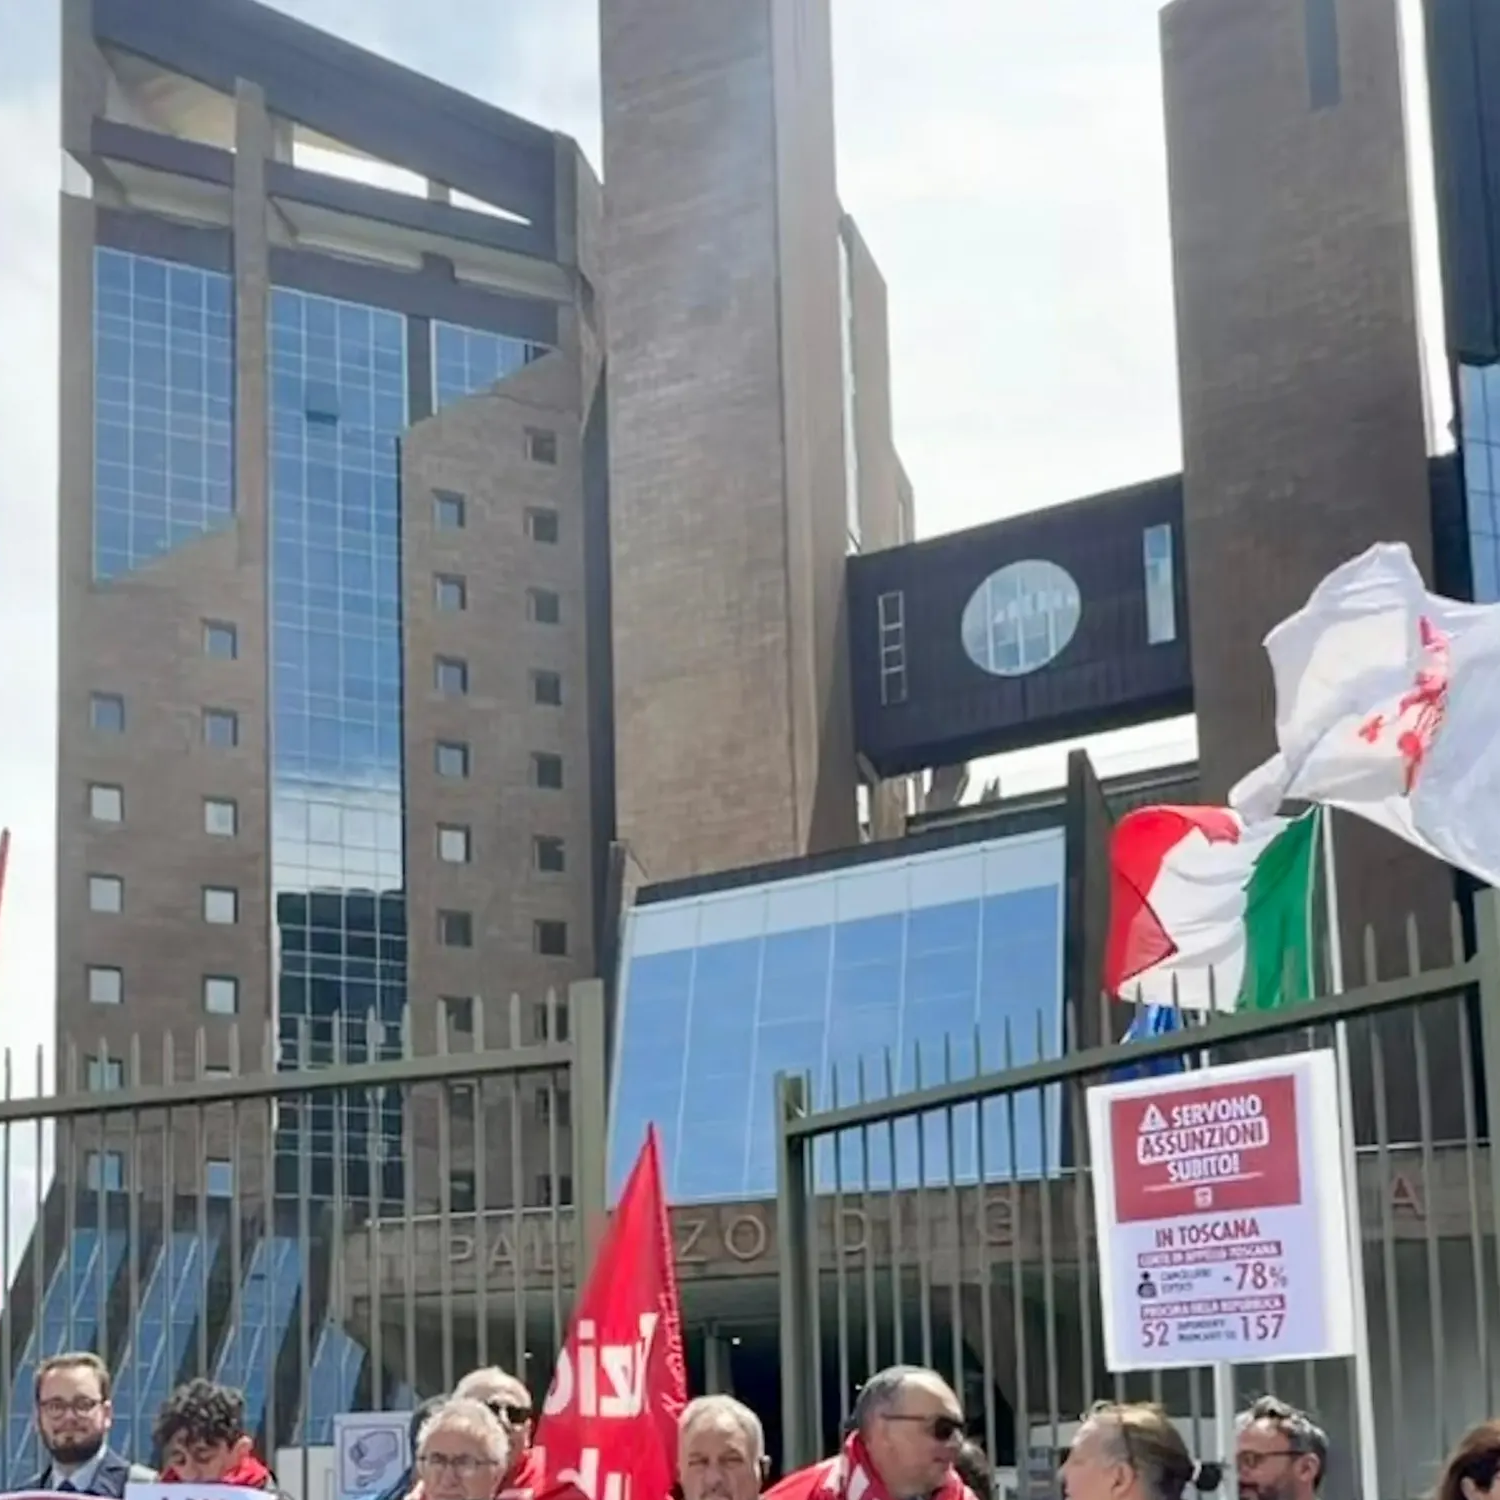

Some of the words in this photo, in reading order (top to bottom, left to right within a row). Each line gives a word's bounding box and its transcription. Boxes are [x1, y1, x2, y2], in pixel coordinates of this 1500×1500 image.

[1171, 1094, 1262, 1128] SERVONO
[1142, 1121, 1264, 1158] ASSUNZIONI
[1156, 1226, 1174, 1248] IN
[1178, 1217, 1260, 1245] TOSCANA
[1142, 1321, 1169, 1348] 52
[1240, 1313, 1285, 1341] 157
